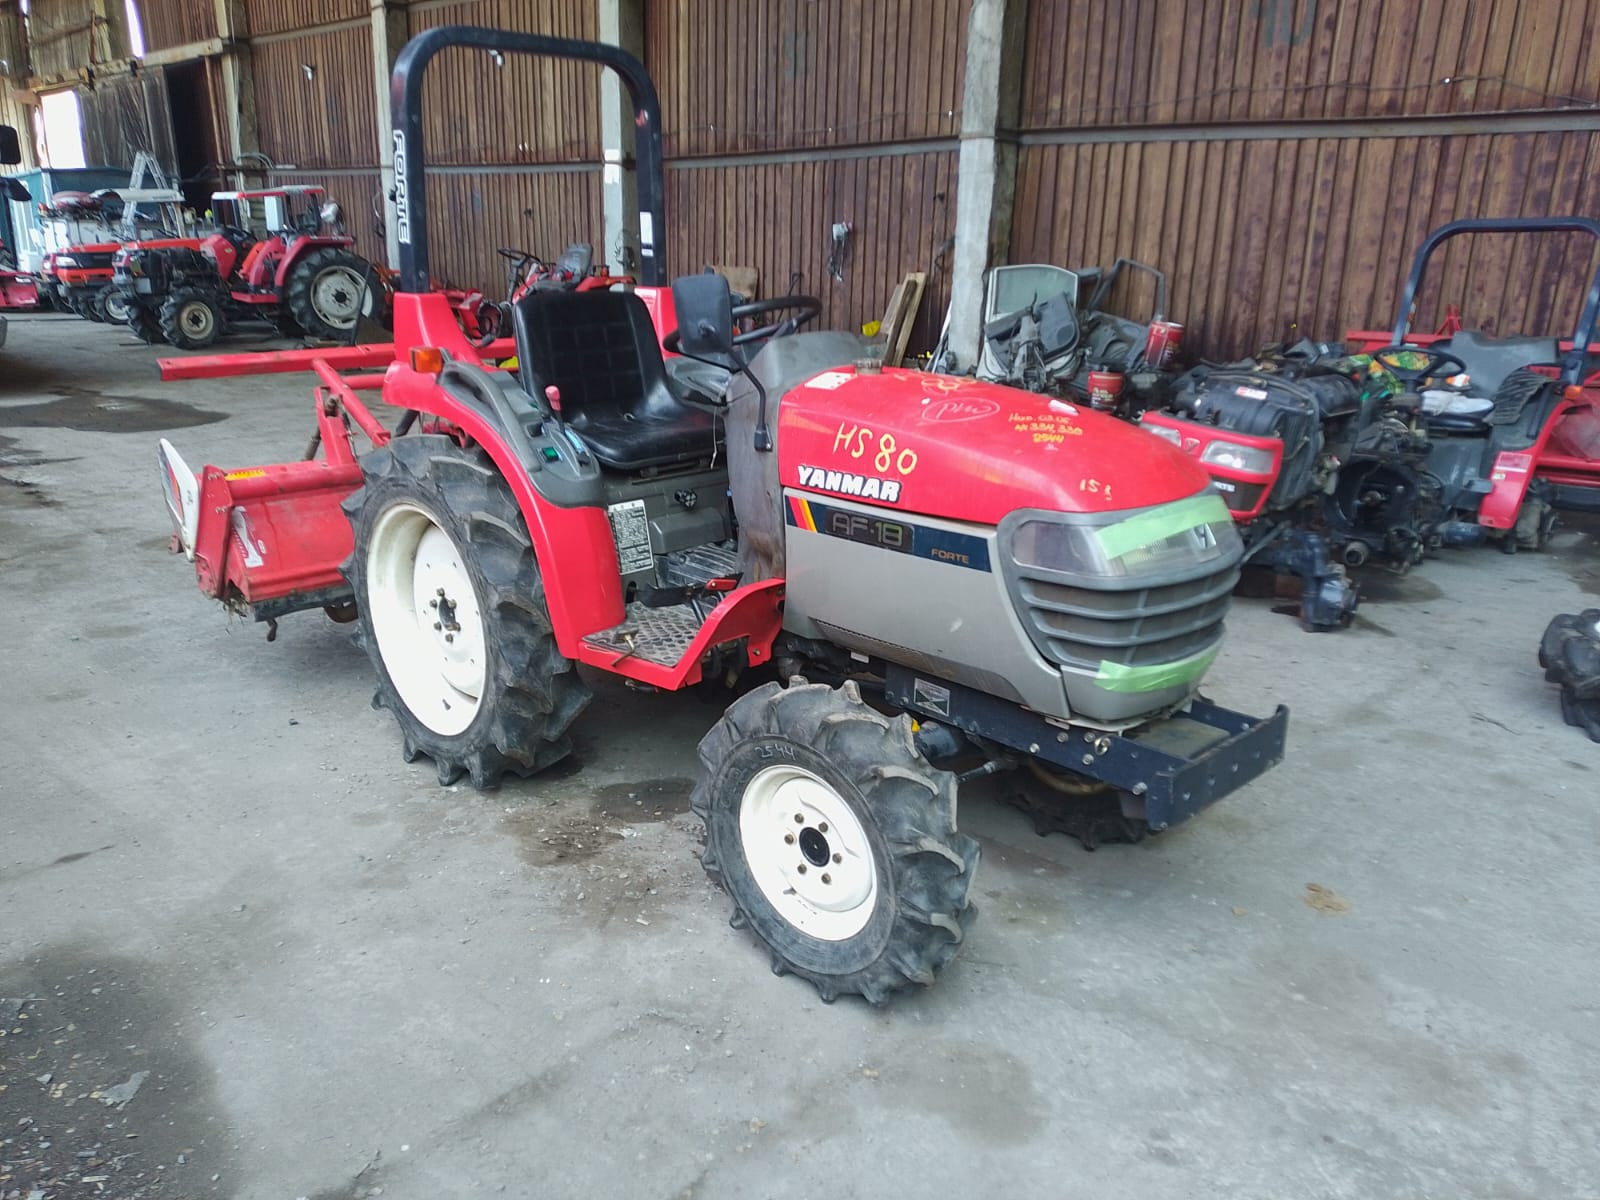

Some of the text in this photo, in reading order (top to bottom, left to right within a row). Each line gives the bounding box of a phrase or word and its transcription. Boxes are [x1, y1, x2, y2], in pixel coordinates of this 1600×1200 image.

[393, 129, 411, 244] FORTE
[797, 464, 902, 503] YANMAR
[931, 548, 970, 564] FORTE
[754, 743, 796, 760] 2544
